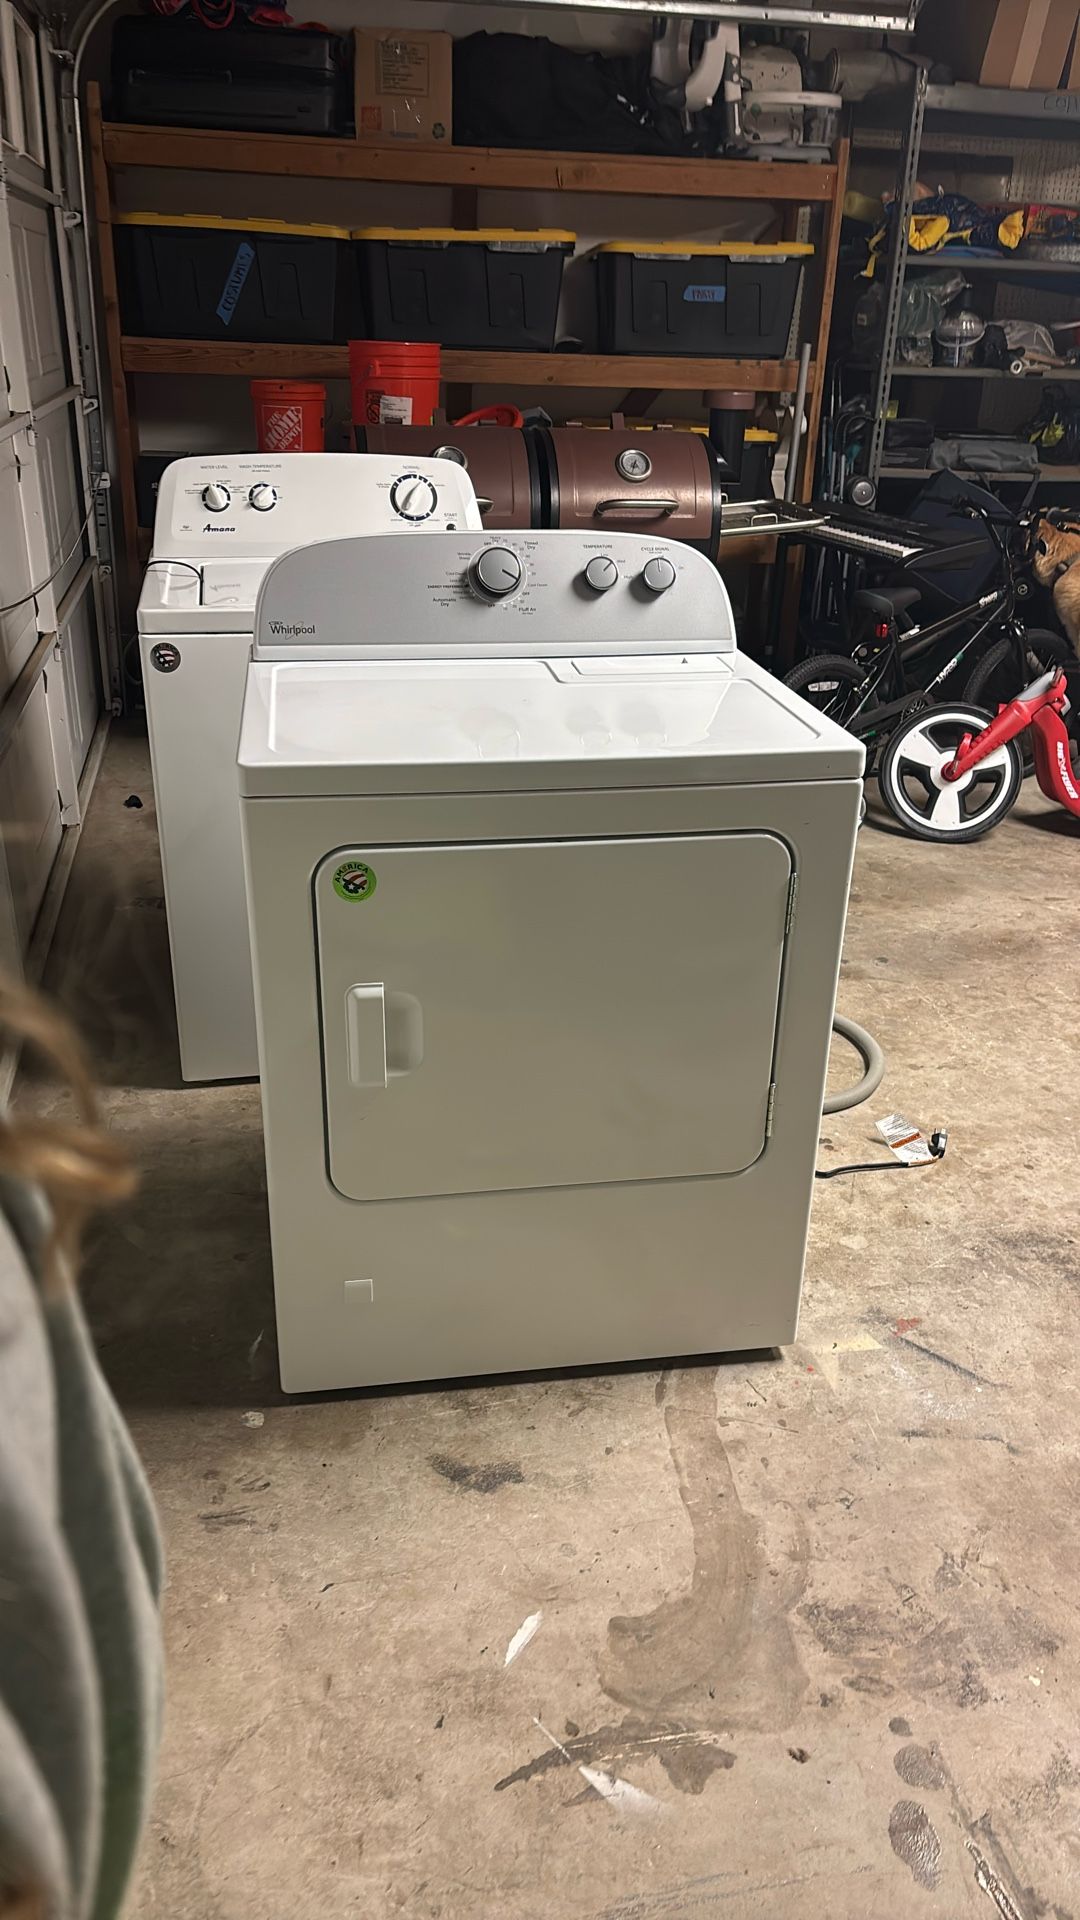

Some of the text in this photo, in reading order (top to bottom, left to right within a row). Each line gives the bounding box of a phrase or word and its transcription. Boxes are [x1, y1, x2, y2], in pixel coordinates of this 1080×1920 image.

[265, 406, 302, 449] HOME
[202, 523, 236, 533] Amana
[270, 624, 316, 636] Whirlpool
[335, 863, 369, 883] AMERICA
